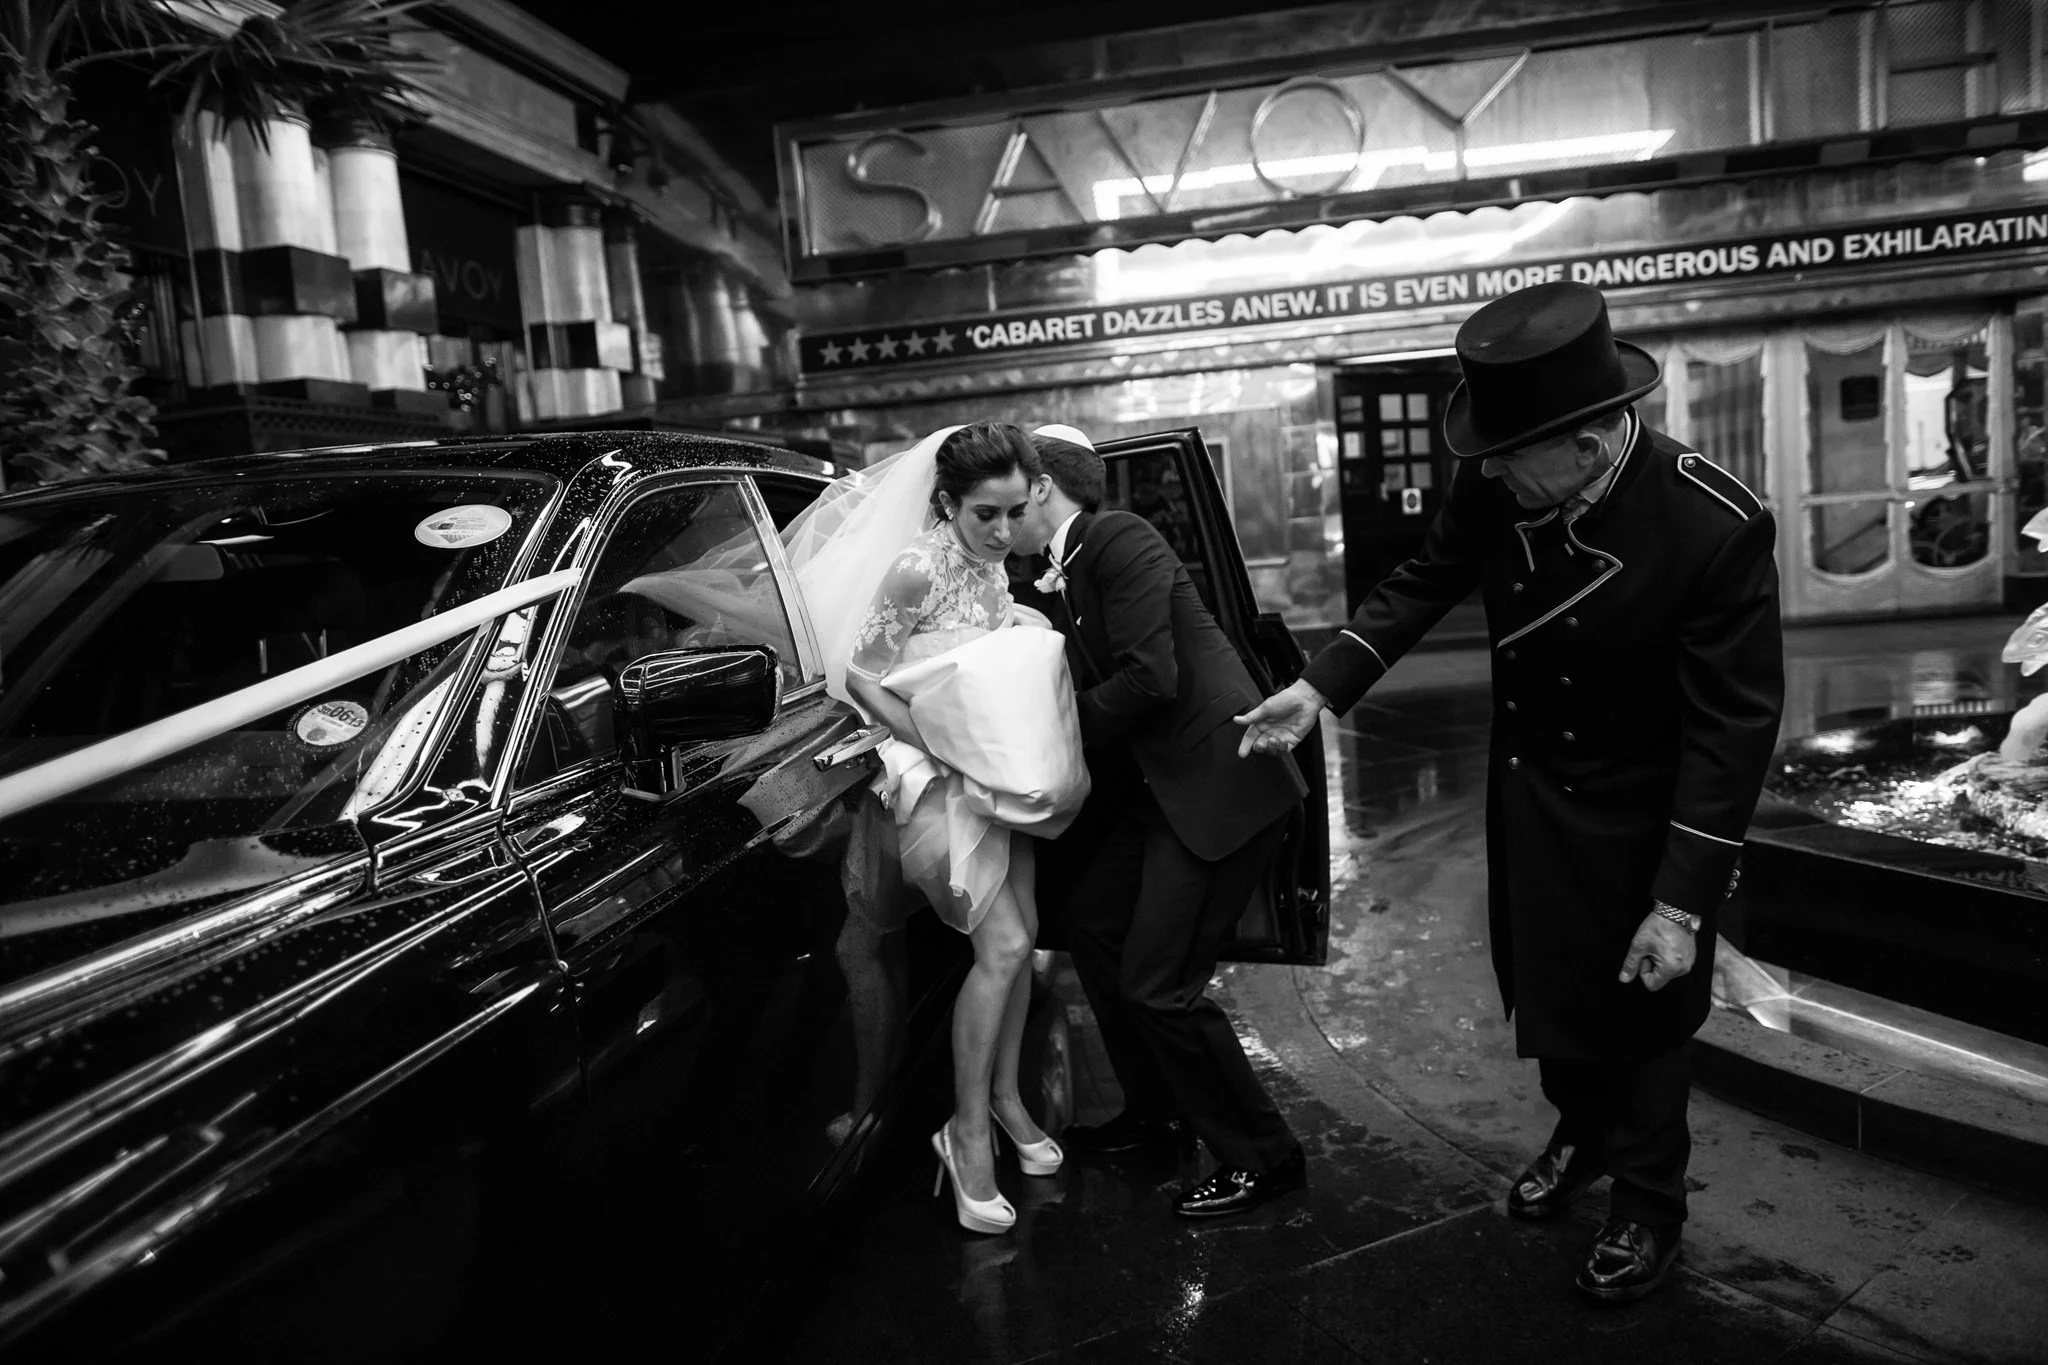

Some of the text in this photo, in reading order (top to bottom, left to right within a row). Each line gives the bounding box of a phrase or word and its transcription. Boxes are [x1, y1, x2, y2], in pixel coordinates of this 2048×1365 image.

[842, 48, 1532, 247] SAVOY
[420, 247, 504, 303] AVOY
[1102, 300, 1225, 336] DAZZLES
[1231, 288, 1324, 324] ANEW.
[1328, 285, 1353, 312] IT
[1360, 279, 1387, 308] IS
[1395, 273, 1470, 306] EVEN
[1571, 245, 1761, 287] DANGEROUS
[1767, 236, 1835, 269] AND
[1844, 214, 2048, 260] EXHILARATIN
